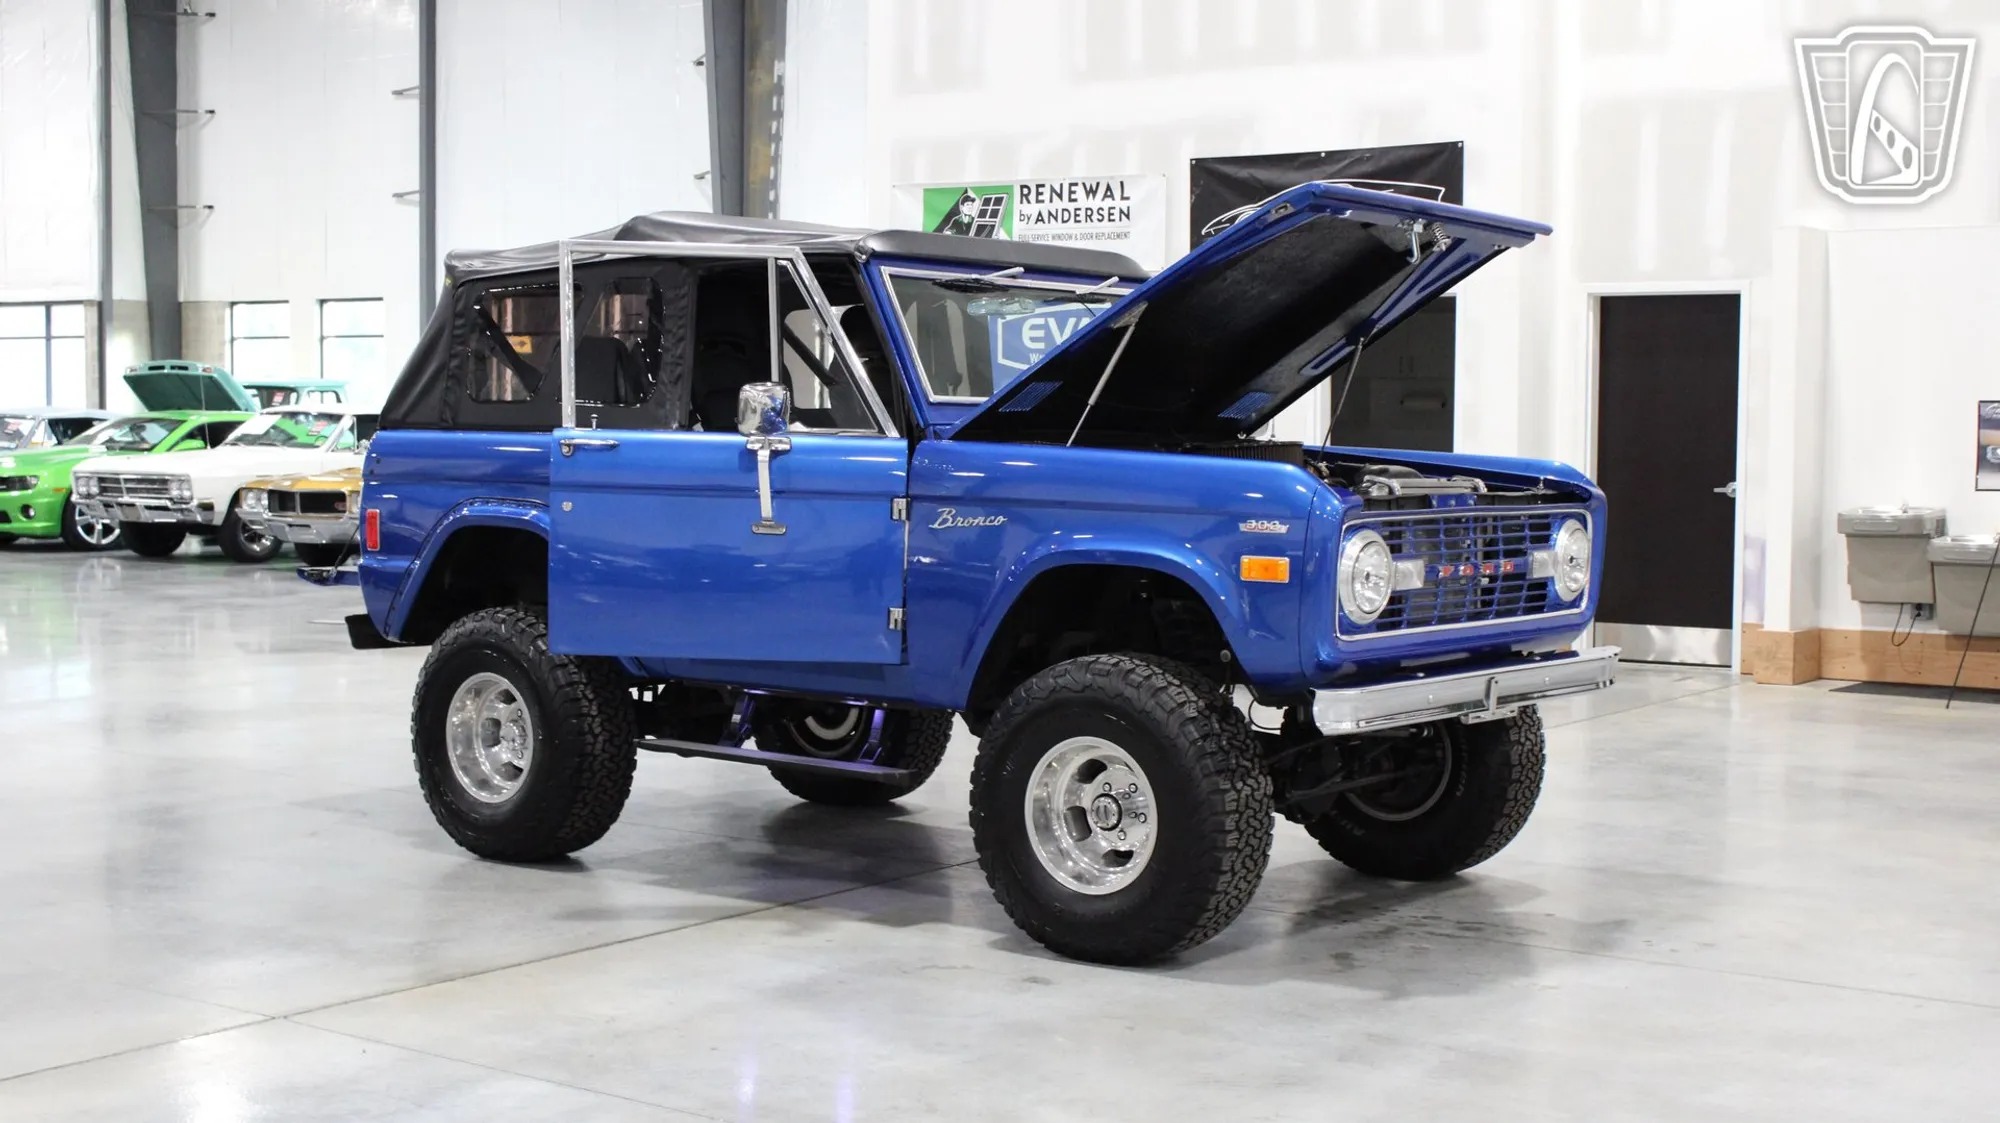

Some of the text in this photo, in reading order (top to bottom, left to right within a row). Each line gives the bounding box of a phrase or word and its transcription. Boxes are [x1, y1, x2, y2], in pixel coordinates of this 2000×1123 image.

[1019, 181, 1131, 205] RENEWAL
[1019, 206, 1131, 225] by ANDERSEN
[1051, 232, 1073, 242] WINDOW
[1079, 232, 1094, 241] DOOR
[1095, 231, 1131, 241] REPLACEMENT
[928, 507, 1008, 529] Bronco
